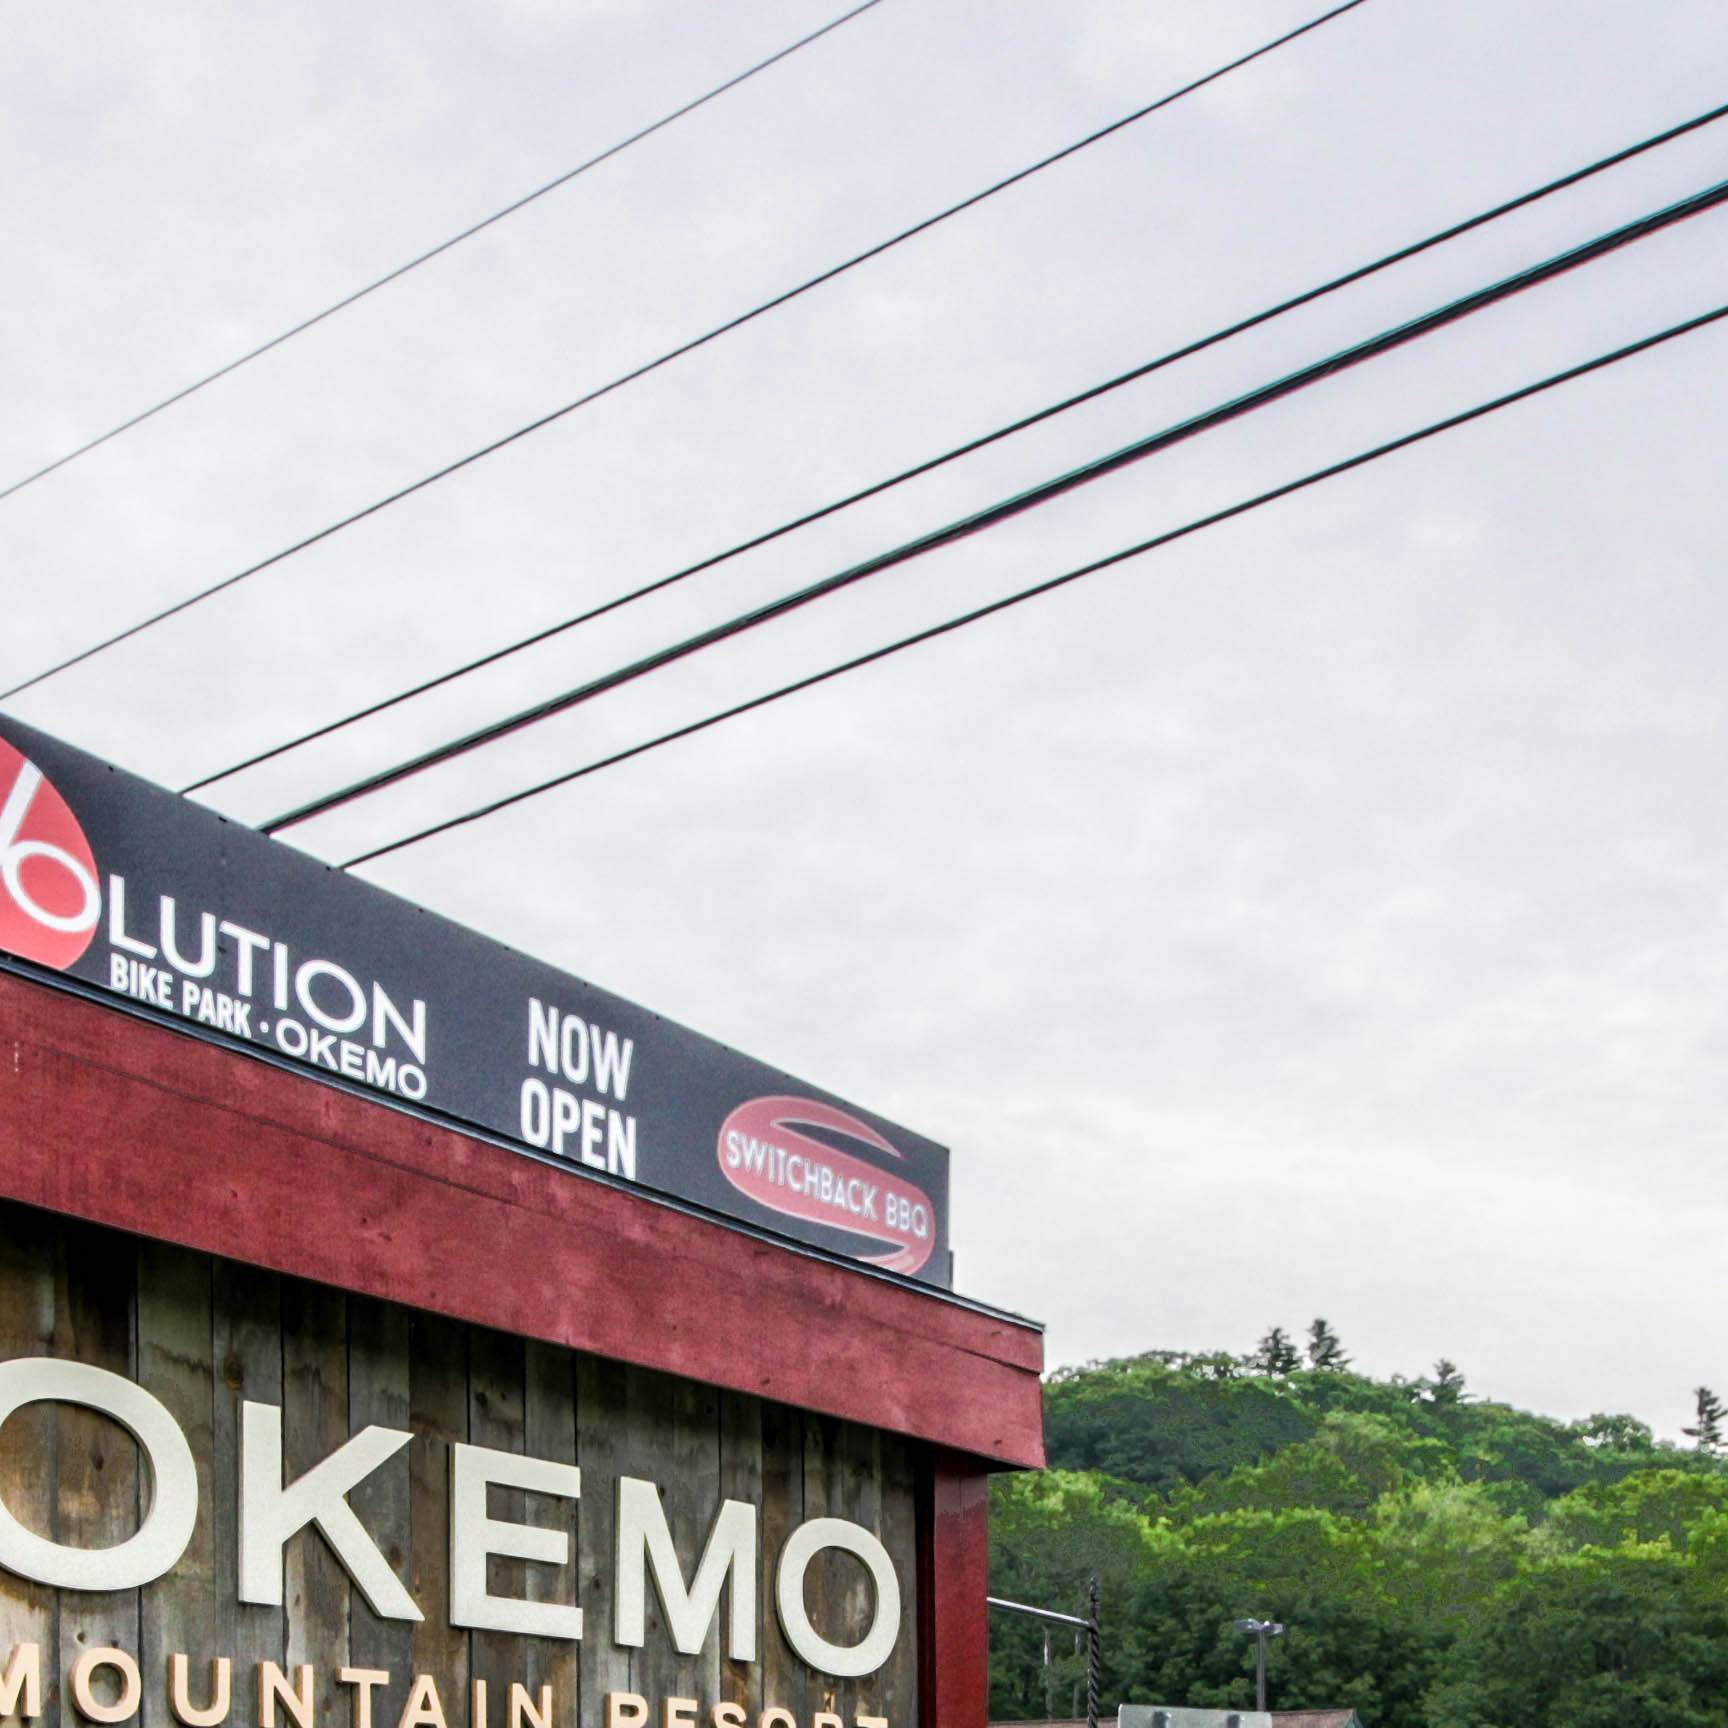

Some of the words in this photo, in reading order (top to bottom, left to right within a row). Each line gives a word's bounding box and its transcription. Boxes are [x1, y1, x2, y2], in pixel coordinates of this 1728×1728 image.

[109, 952, 173, 1009] BIKE
[182, 979, 252, 1038] PARK
[275, 1018, 427, 1100] OKEMO
[528, 996, 633, 1100] NOW
[521, 1078, 636, 1179] OPEN
[726, 1130, 879, 1222] SWITCHBACK
[885, 1192, 928, 1238] BBQ
